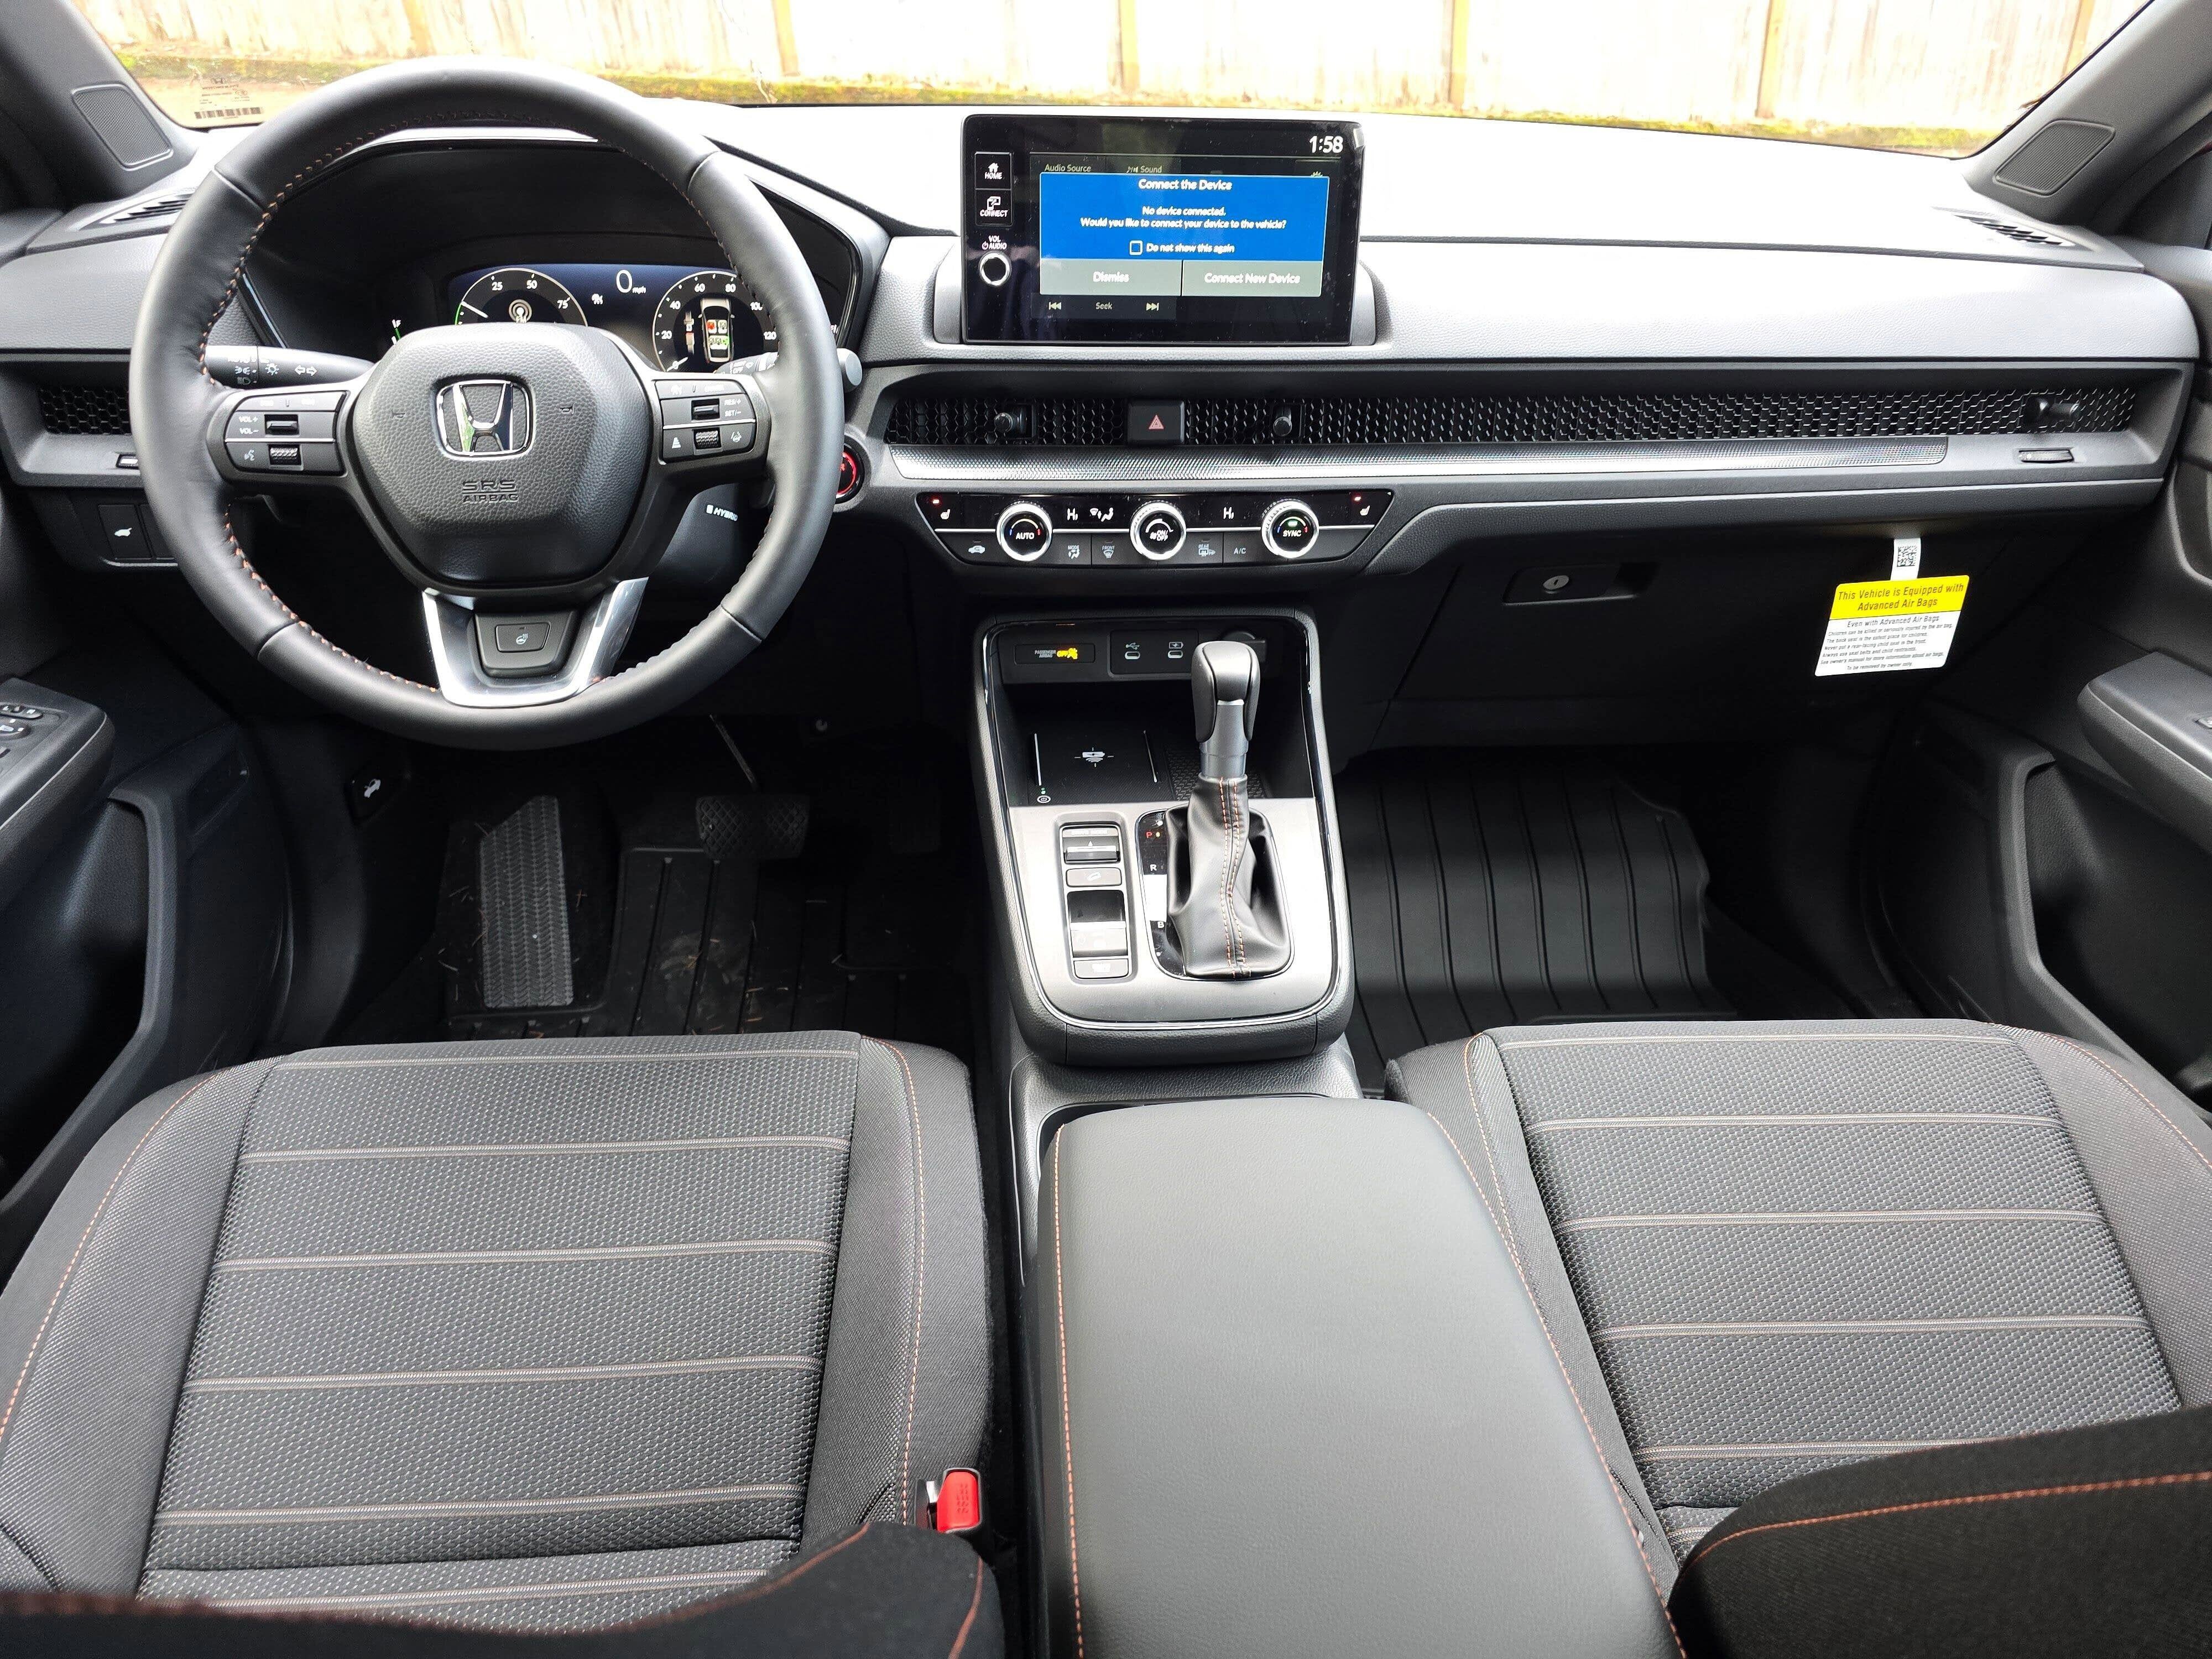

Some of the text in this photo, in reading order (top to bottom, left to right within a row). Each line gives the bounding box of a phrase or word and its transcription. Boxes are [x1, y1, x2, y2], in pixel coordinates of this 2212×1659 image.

[1310, 135, 1343, 153] 1:58
[1044, 164, 1092, 173] Audio Source
[1140, 165, 1162, 174] Sound
[1138, 179, 1233, 190] Connect the Device
[1142, 206, 1155, 215] No
[1156, 206, 1182, 216] device
[1080, 217, 1287, 229] Would you like to connect your device to the vehicle?
[1146, 243, 1235, 254] Do not show this again
[616, 269, 633, 293] 0
[1093, 271, 1129, 283] Dismiss
[1204, 273, 1301, 284] Connect New Device
[492, 281, 503, 291] 25
[526, 280, 538, 289] 50
[694, 283, 706, 293] 60
[725, 283, 736, 293] 80
[557, 300, 568, 309] 75
[670, 300, 681, 310] 40
[661, 330, 672, 340] 20
[462, 480, 517, 492] SRS
[463, 494, 519, 504] AIRBAG
[1838, 583, 1964, 601] This Vehicle is Equipped with
[1858, 598, 1938, 611] Advanced Air Bags
[1879, 617, 1911, 625] Advanced
